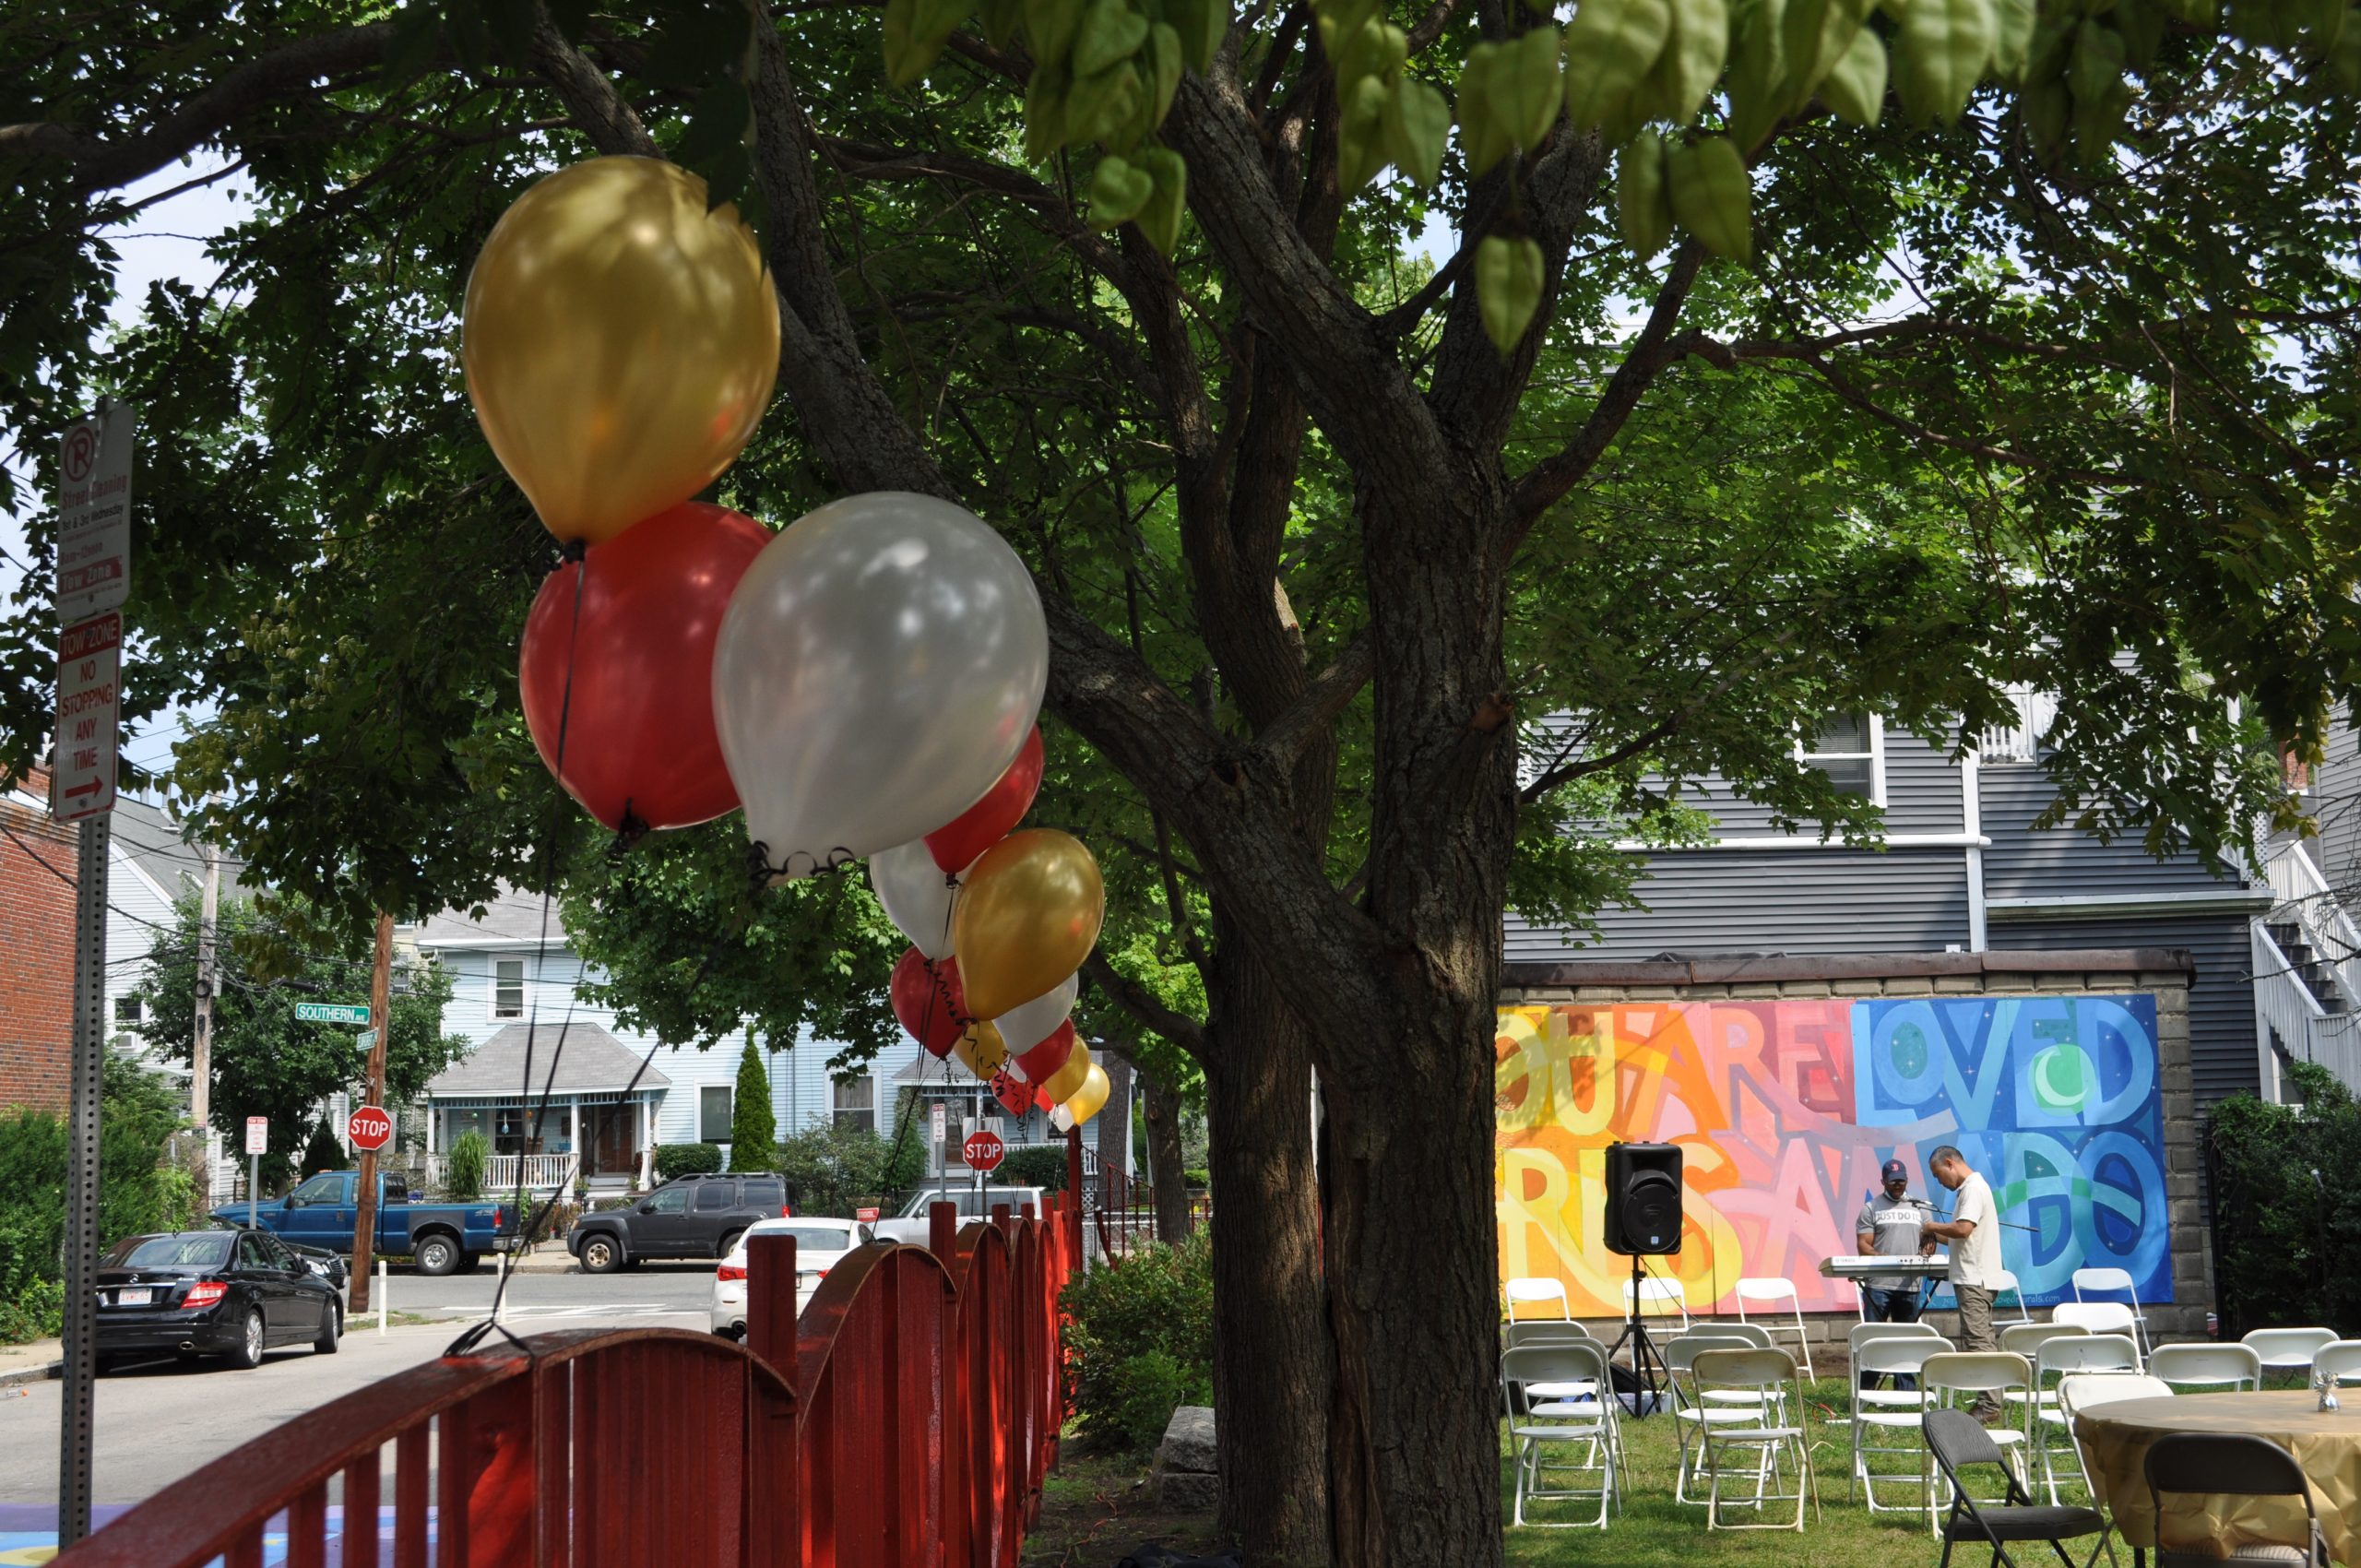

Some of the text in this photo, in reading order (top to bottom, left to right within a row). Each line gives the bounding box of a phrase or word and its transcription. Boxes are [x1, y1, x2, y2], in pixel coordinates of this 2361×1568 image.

[63, 473, 127, 510] Street Cleaning
[90, 505, 124, 522] Wednesday
[62, 564, 112, 592] Tow Zone
[63, 619, 118, 656] TOW ZONE
[80, 660, 96, 683] NO
[62, 685, 113, 717] STOPPING
[75, 718, 97, 742] ANY
[74, 747, 98, 772] TIME
[299, 1005, 355, 1021] SOUTHERN
[1496, 999, 2153, 1138] OU ARE LOVED
[350, 1119, 389, 1138] STOP
[966, 1144, 1001, 1158] STOP
[1877, 1210, 1896, 1222] JUST
[1897, 1211, 1911, 1220] DO
